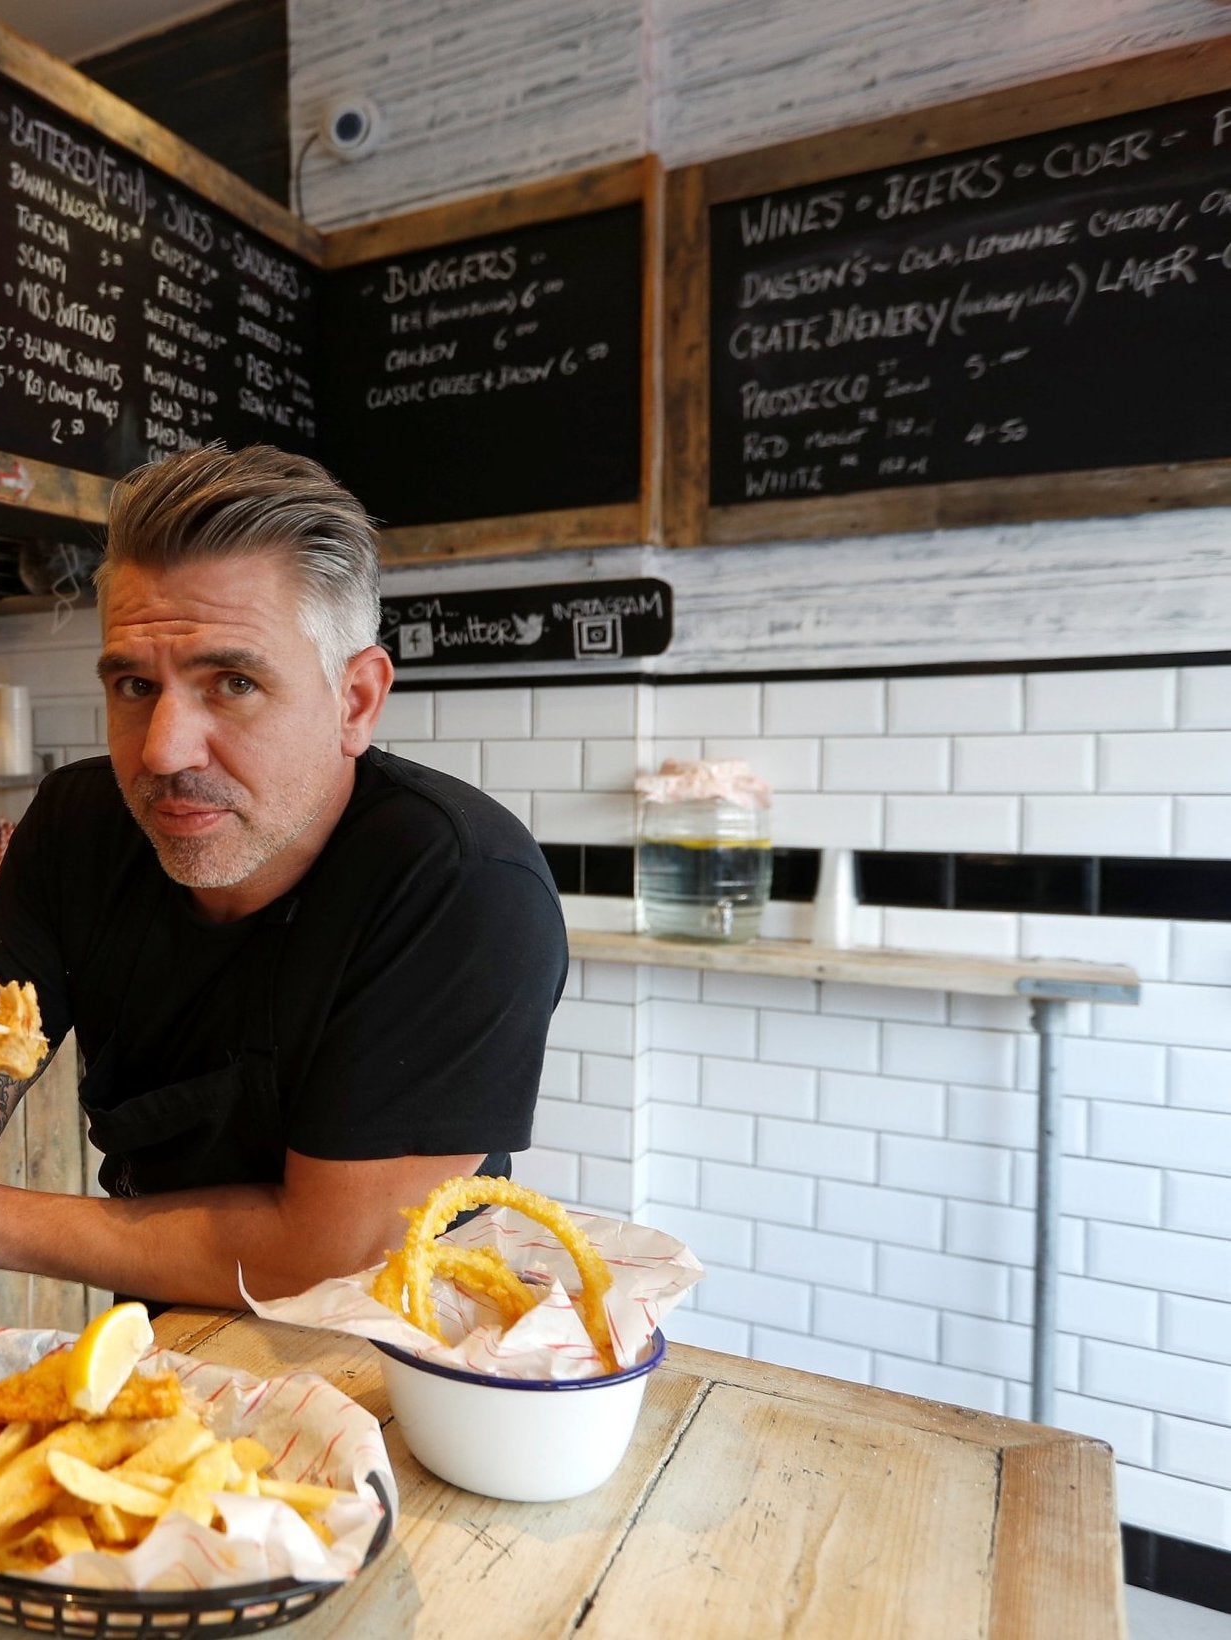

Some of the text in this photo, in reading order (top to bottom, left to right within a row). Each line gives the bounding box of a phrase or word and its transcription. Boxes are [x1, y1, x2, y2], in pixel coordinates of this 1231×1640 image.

[740, 191, 846, 247] WINES
[876, 154, 1004, 220] BEERS
[1043, 129, 1154, 180] CIDER
[17, 242, 67, 284] SCAMPI
[382, 246, 518, 303] BURGERS
[728, 314, 823, 360] CRATE
[1096, 244, 1198, 298] LAGER
[385, 340, 458, 373] CHICKEN
[366, 381, 426, 410] CLASSIC
[739, 373, 871, 420] PROSECCO
[745, 463, 825, 498] WHITE
[552, 591, 664, 622] INSTAGRAM
